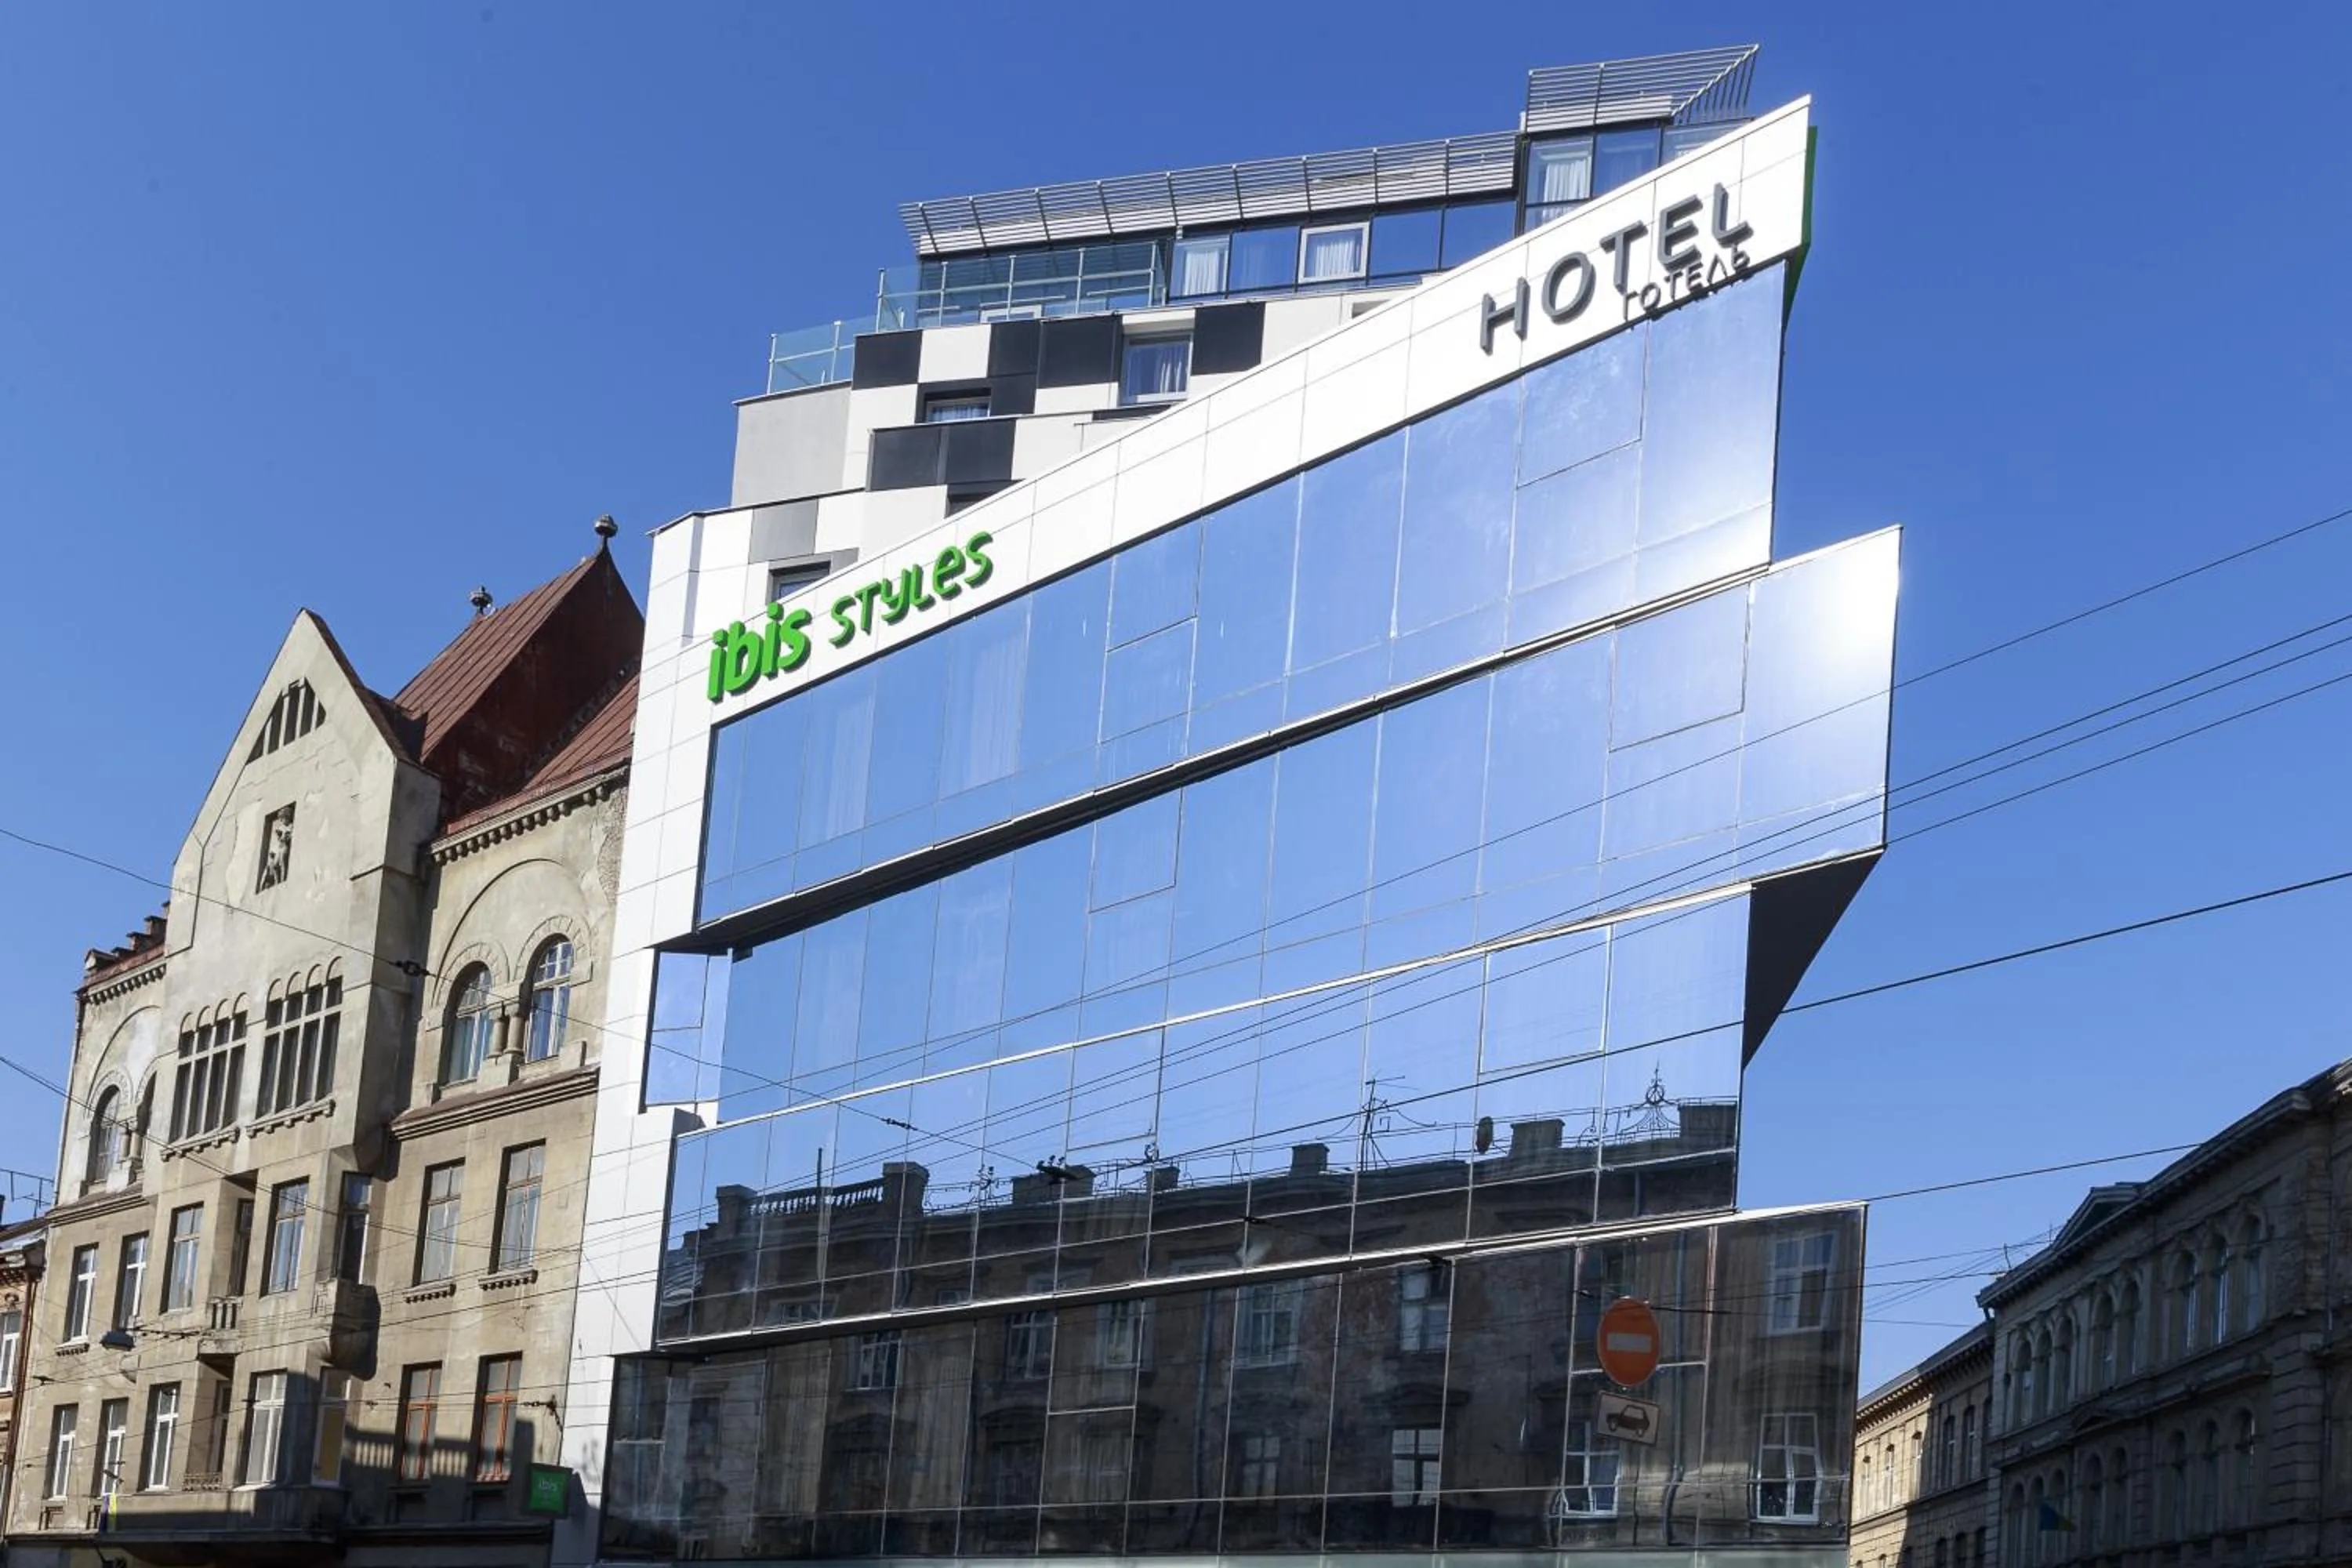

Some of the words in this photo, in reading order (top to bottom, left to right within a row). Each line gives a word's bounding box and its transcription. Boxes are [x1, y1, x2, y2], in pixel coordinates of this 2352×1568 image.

[1480, 182, 1754, 356] HOTEL
[1623, 244, 1751, 322] ГОТЕЛЬ
[707, 603, 812, 703] ibis
